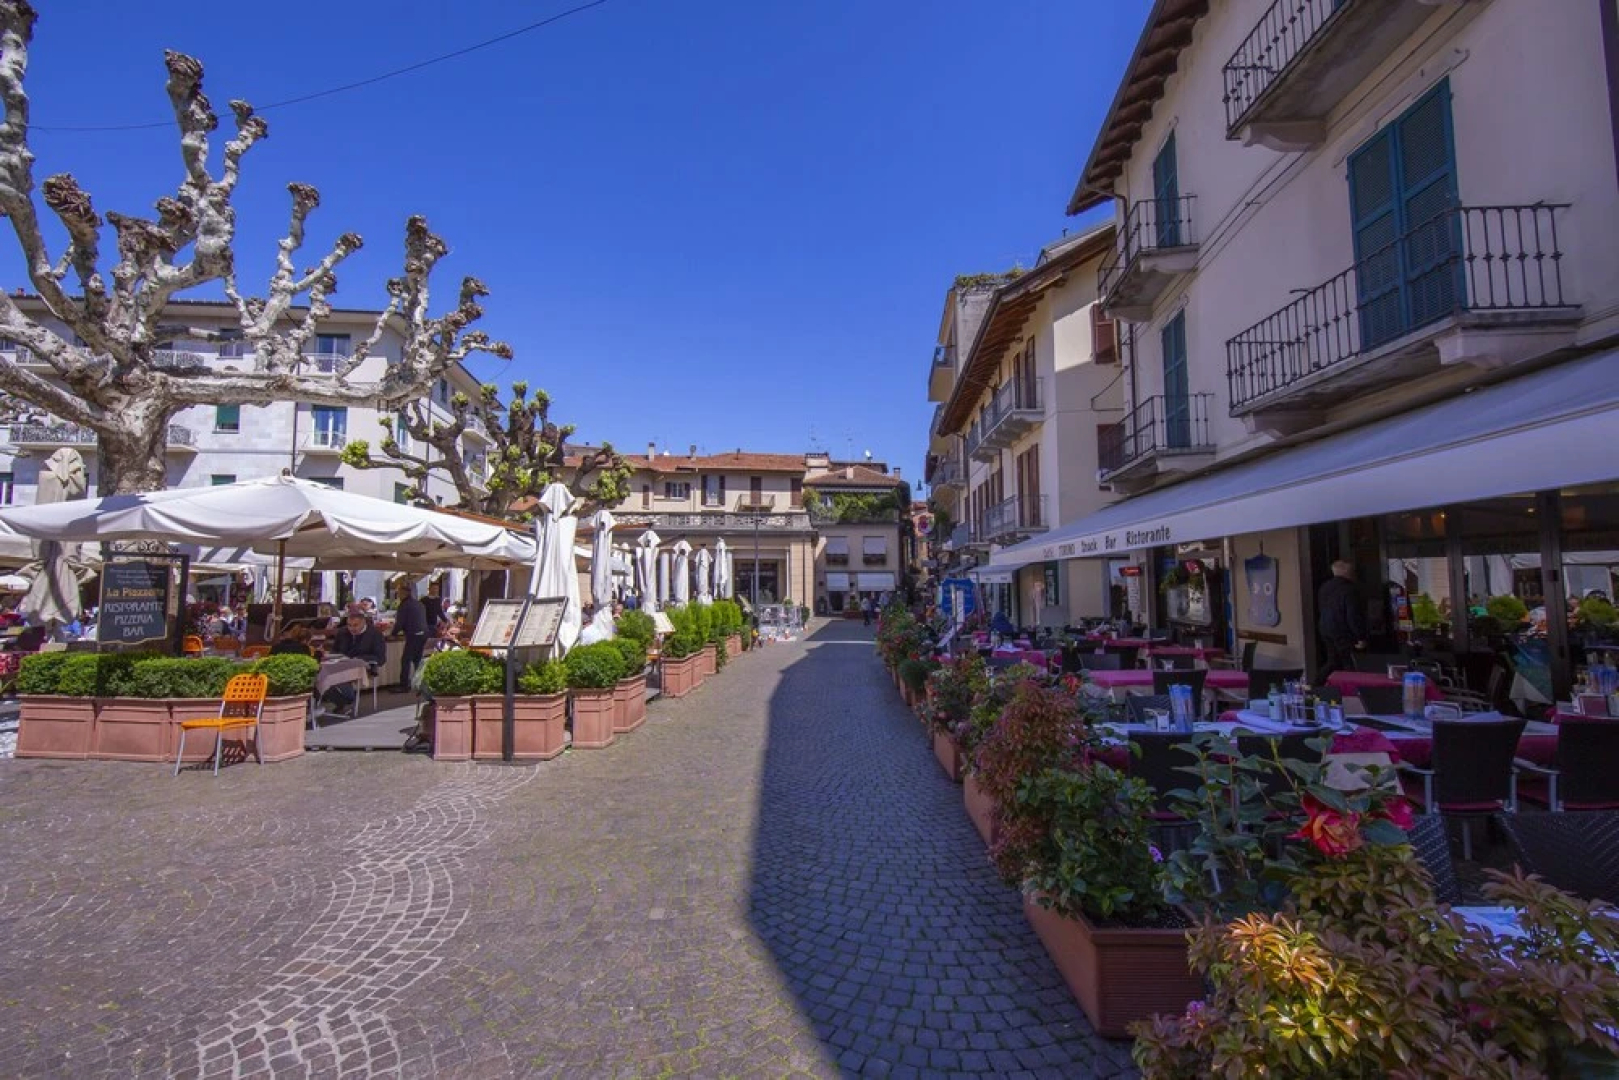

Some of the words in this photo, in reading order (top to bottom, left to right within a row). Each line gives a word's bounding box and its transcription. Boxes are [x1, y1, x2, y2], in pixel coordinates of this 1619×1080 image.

[1105, 535, 1117, 549] Bar
[1126, 525, 1171, 546] Ristorante
[106, 587, 119, 597] La
[104, 601, 165, 613] RISTORANTE
[114, 614, 154, 625] PIZZERIA
[122, 626, 145, 637] BAR
